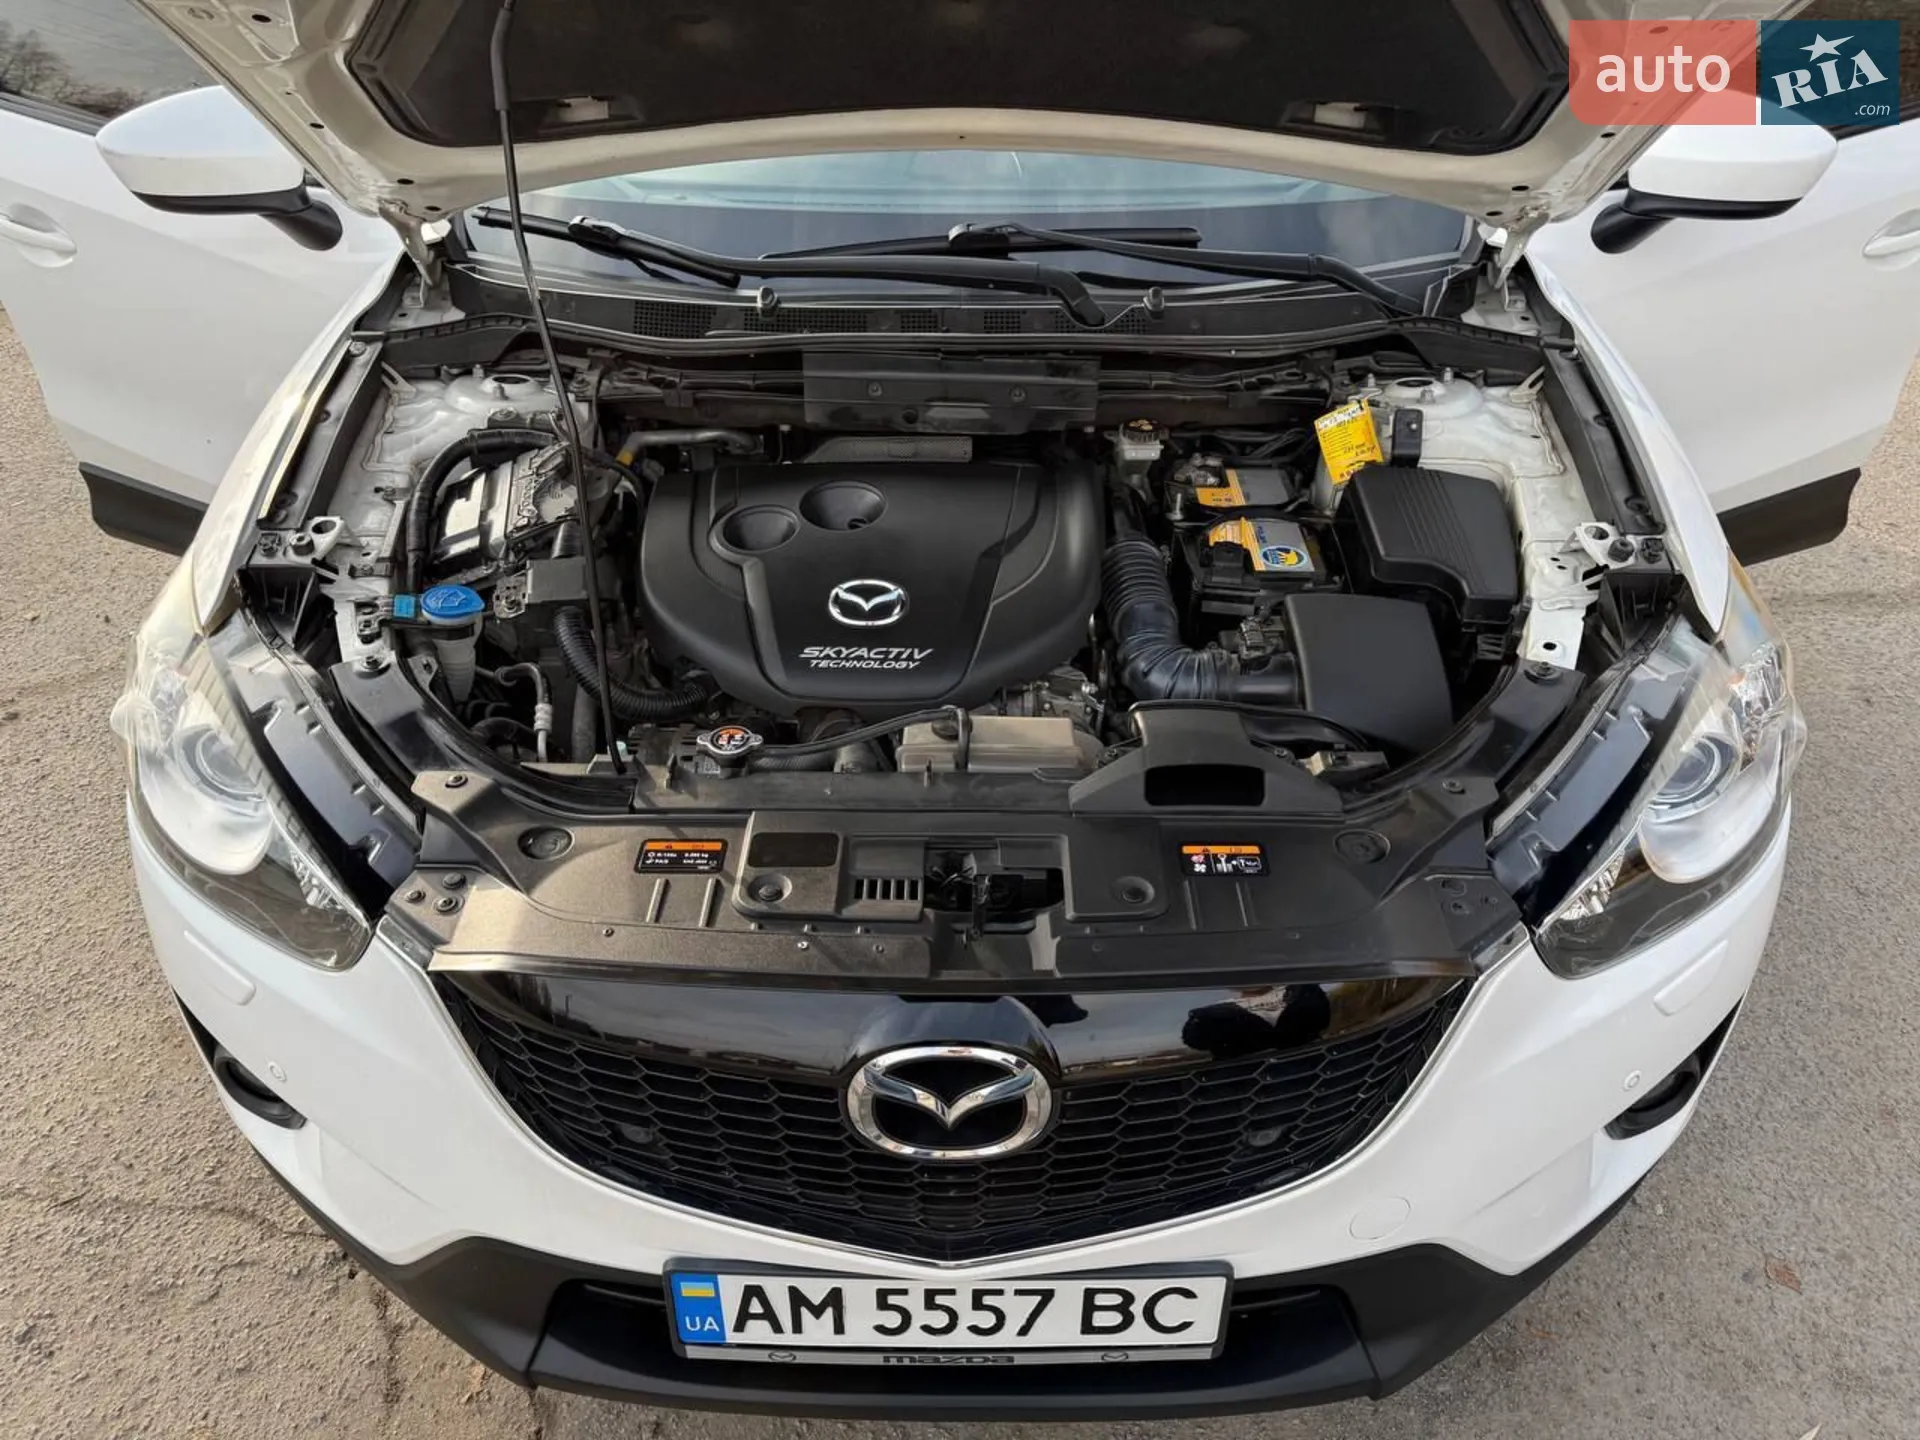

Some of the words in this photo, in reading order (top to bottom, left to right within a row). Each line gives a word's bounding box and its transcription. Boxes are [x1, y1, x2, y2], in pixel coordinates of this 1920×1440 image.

[799, 647, 934, 659] SKYACTIV
[809, 660, 920, 669] TECHNOLOGY
[732, 1284, 845, 1335] AM
[872, 1288, 1055, 1337] 5557
[1080, 1286, 1199, 1336] BC
[685, 1315, 720, 1332] UA
[882, 1355, 1015, 1364] mazda
